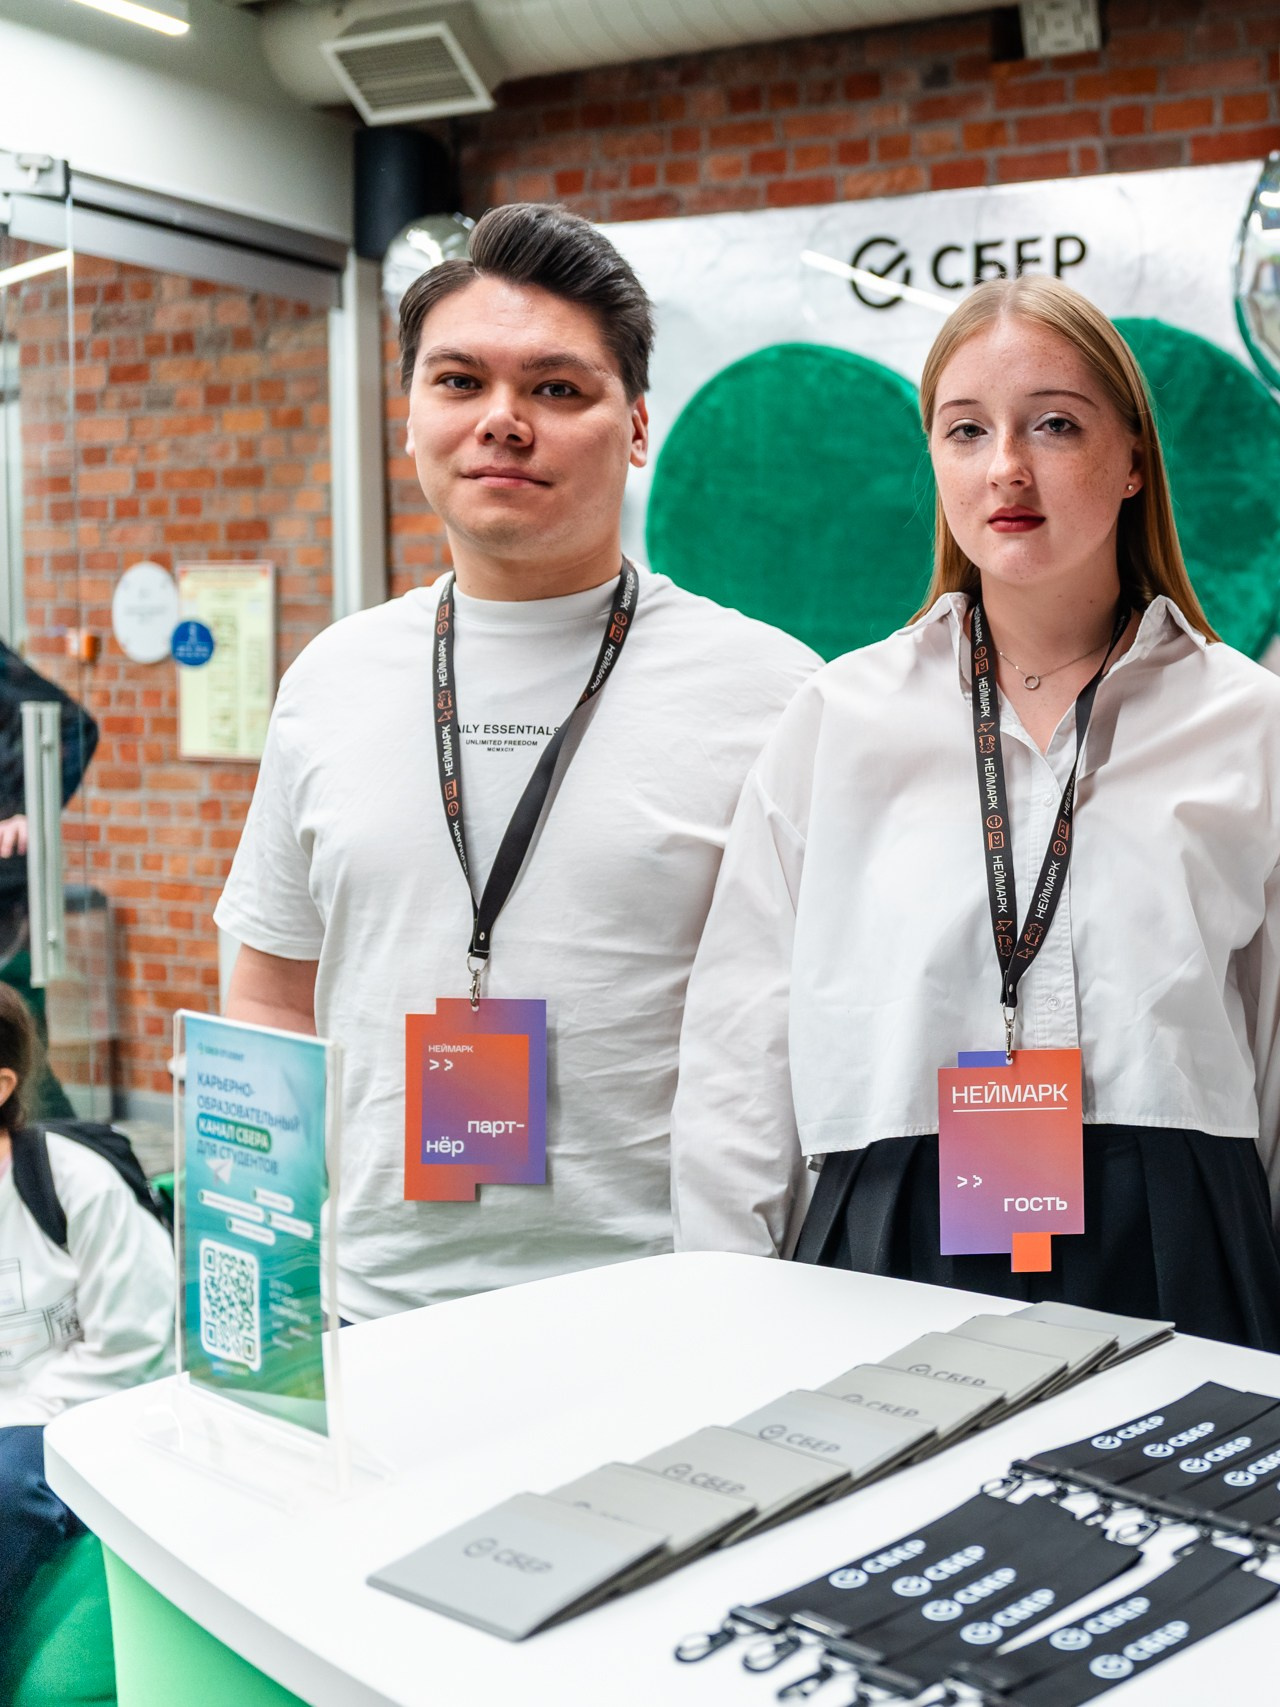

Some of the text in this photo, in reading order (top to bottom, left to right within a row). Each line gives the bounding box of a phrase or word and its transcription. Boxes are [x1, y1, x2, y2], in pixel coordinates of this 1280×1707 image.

[437, 637, 448, 688] НЕЙМАРК
[590, 643, 616, 692] НЕЙМАРК
[978, 677, 991, 718] НЕЙМАРК
[442, 724, 454, 777] НЕЙМАРК
[984, 757, 999, 810] НЕЙМАРК
[992, 855, 1008, 914] НЕЙМАРК
[1035, 860, 1060, 919] НЕЙМАРК
[428, 1044, 474, 1053] НЕЙМАРК
[952, 1081, 1068, 1104] НЕЙМАРК
[467, 1120, 525, 1138] парт-
[426, 1136, 464, 1157] нёр
[1003, 1197, 1068, 1212] гость
[786, 1433, 841, 1453] СБЕР
[690, 1472, 746, 1494] СБЕР
